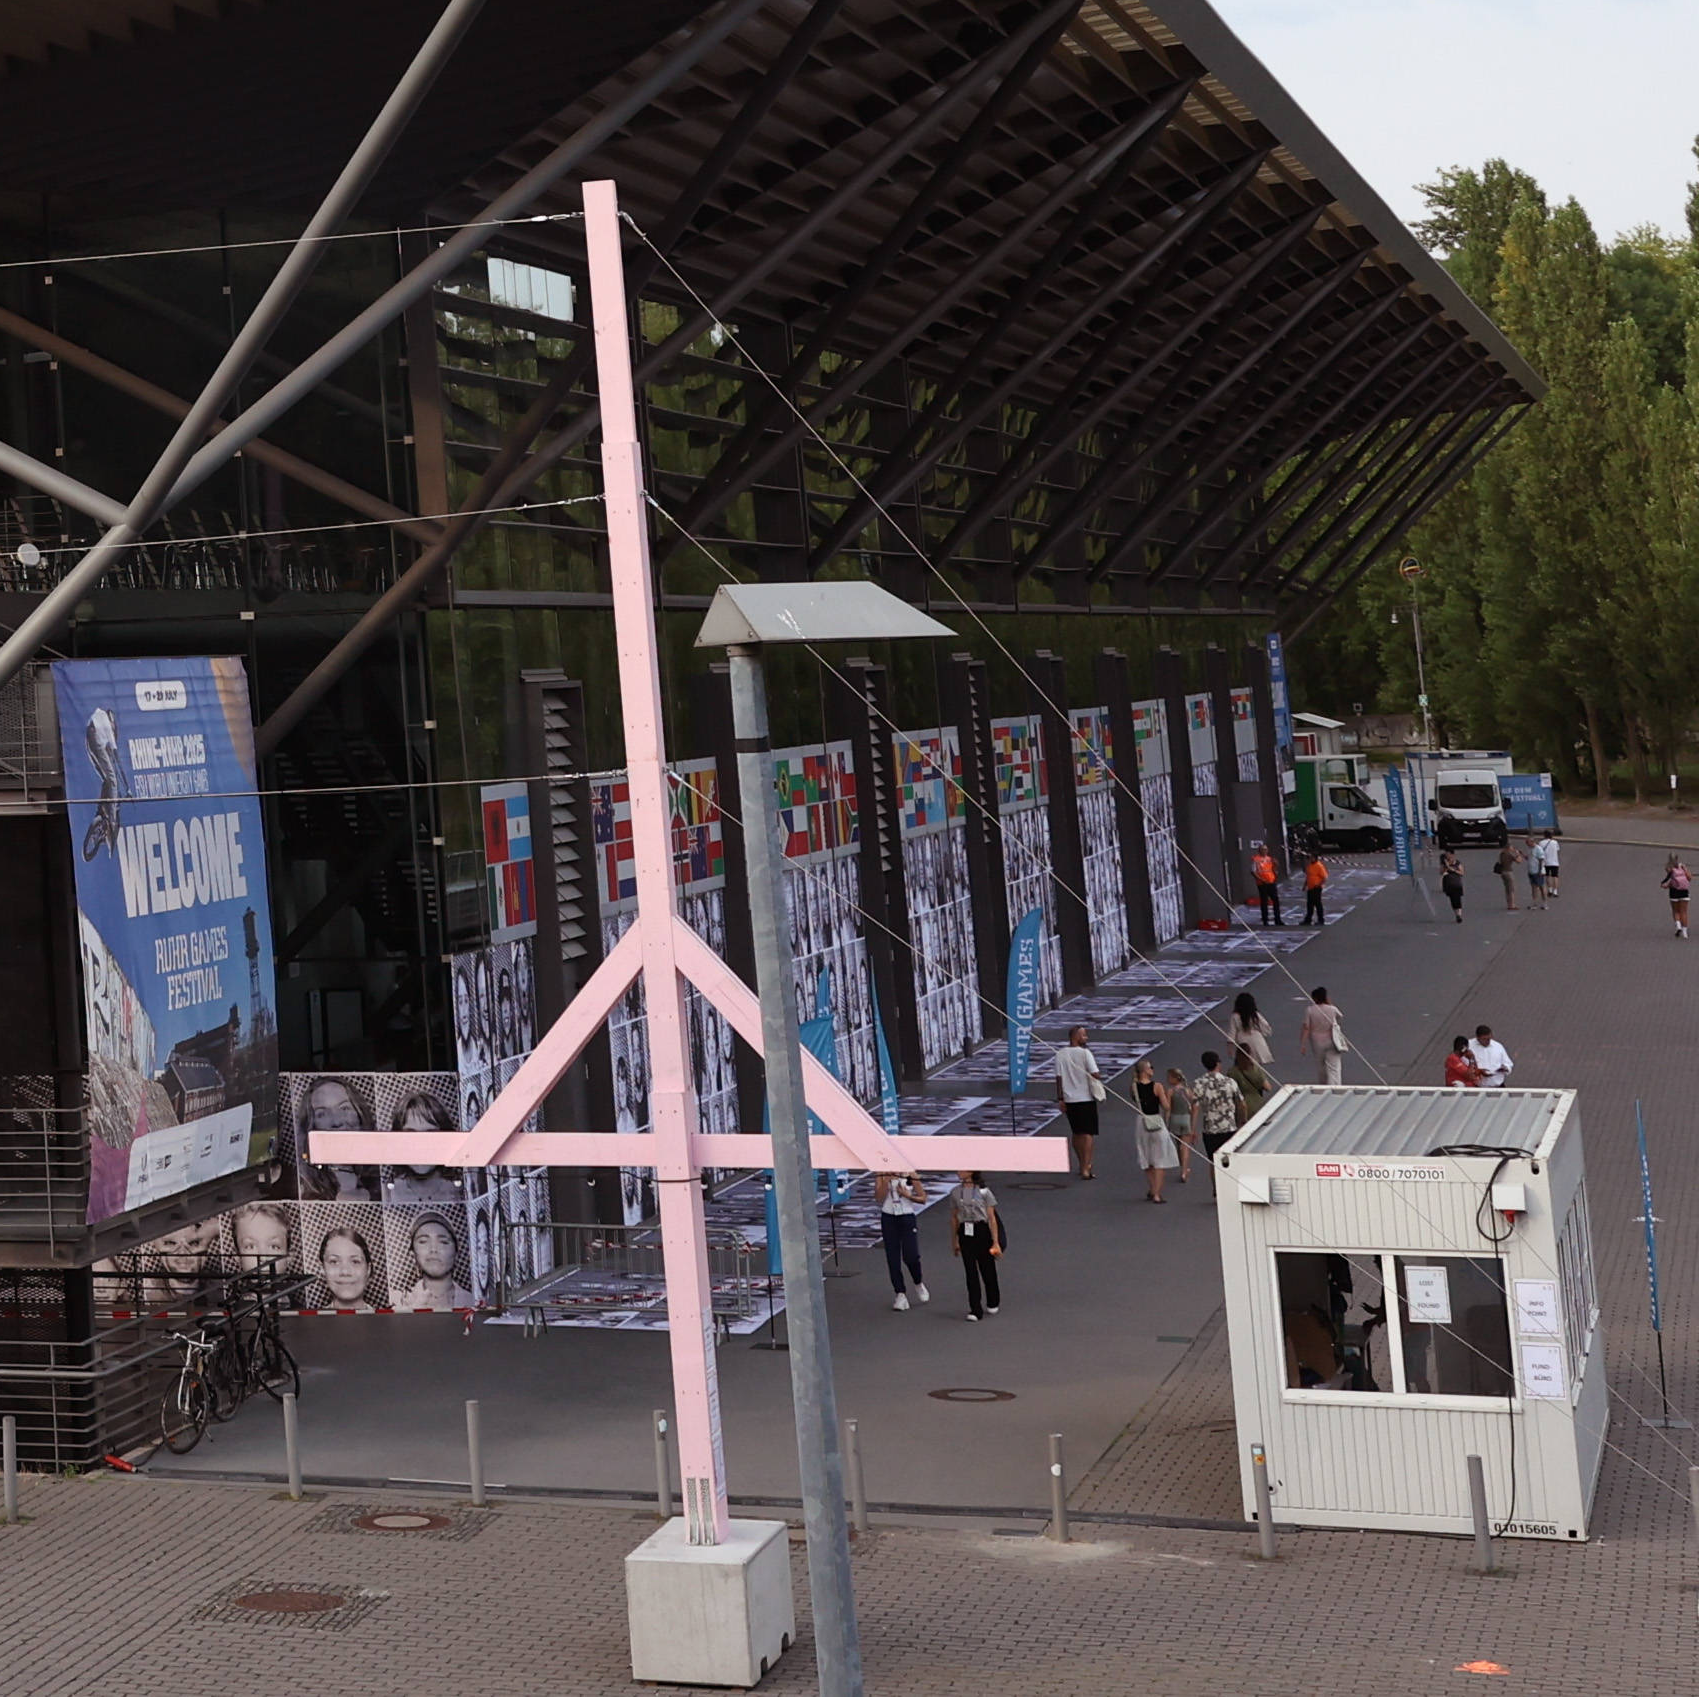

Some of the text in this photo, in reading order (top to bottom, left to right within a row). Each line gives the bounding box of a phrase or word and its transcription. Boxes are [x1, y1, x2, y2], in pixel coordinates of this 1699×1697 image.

[117, 811, 248, 918] WELCOME
[155, 925, 228, 974] RUHR GAMES
[167, 965, 223, 1011] FESTIVAL
[1016, 938, 1035, 1020] GAMES
[1317, 1165, 1339, 1173] SANI
[1358, 1169, 1390, 1179] 0800
[1398, 1170, 1445, 1180] 7070101
[1493, 1523, 1558, 1535] 01015605
